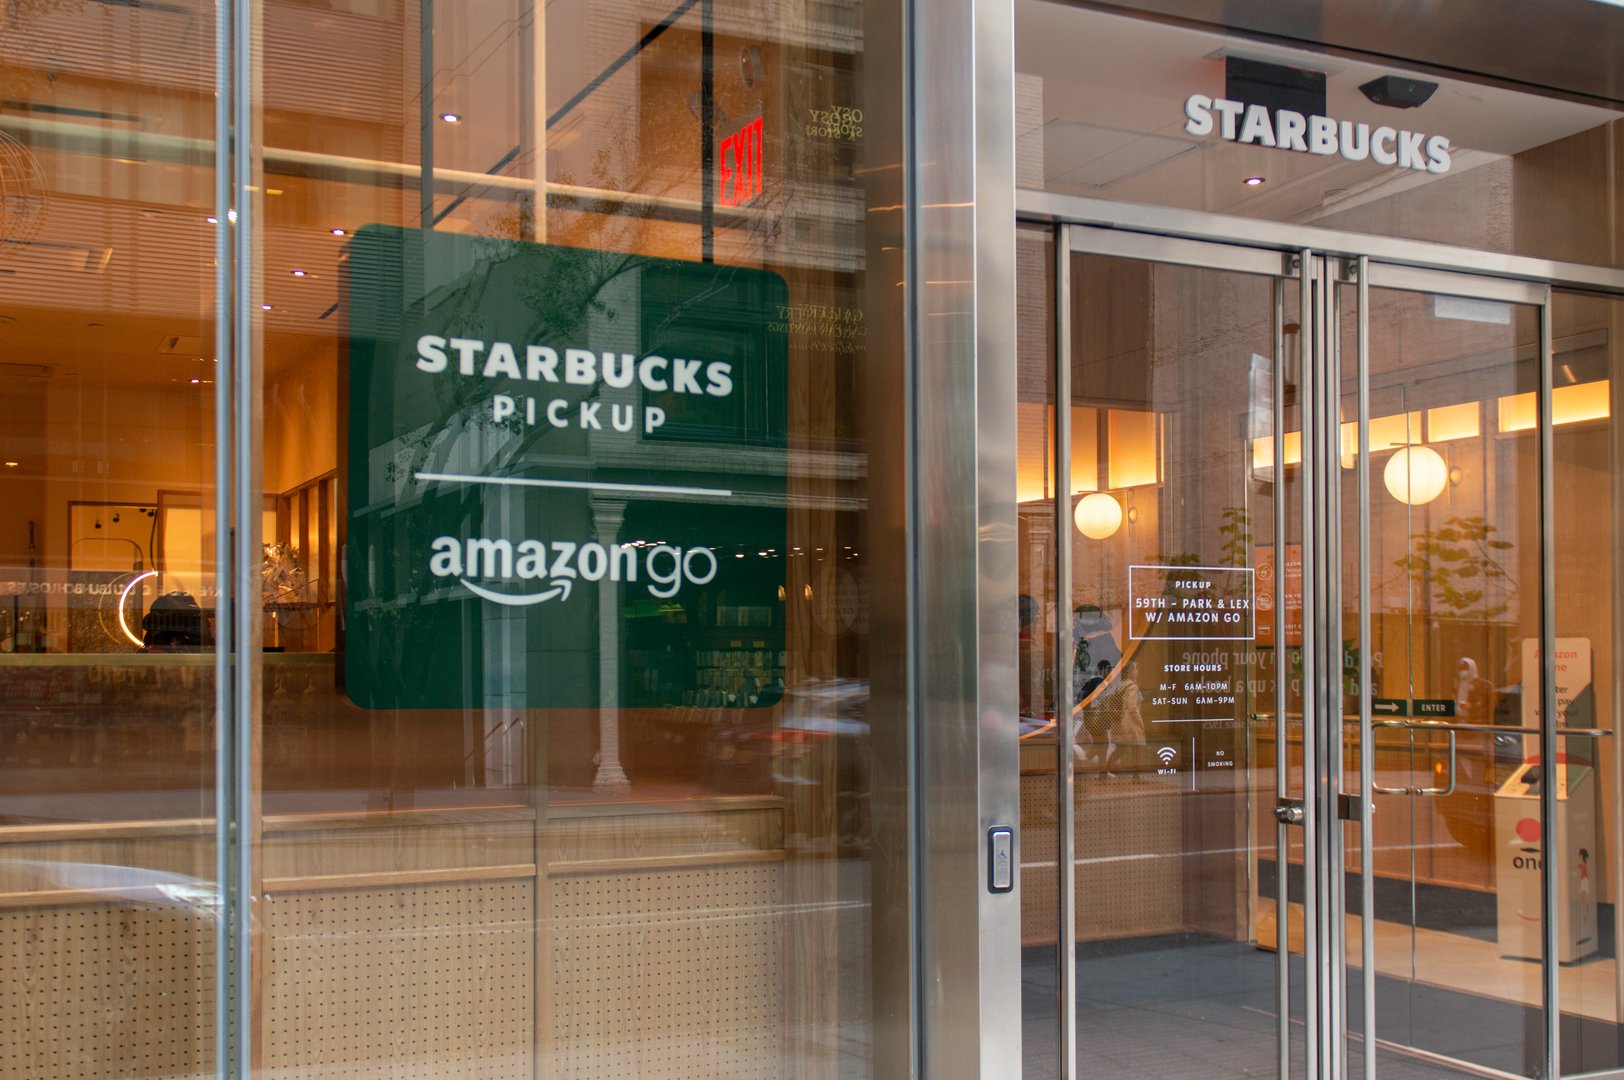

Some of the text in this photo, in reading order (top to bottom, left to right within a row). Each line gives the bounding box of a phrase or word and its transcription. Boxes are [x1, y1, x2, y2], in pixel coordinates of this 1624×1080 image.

[1184, 94, 1451, 174] STARBUCKS
[720, 115, 763, 208] EXIT
[416, 334, 733, 397] STARBUCKS
[493, 395, 666, 433] PICKUP
[430, 536, 718, 599] amazon go
[1175, 580, 1211, 589] PICKUP
[1135, 598, 1166, 609] 59TH
[1182, 598, 1213, 609] PARK
[1217, 599, 1225, 609] &
[1230, 599, 1250, 609] LEX
[1145, 612, 1241, 623] W/ AMAZON GO
[1164, 664, 1222, 672] STORE HOURS
[1160, 683, 1228, 691] M-F 6AM-10PM
[1152, 697, 1235, 705] SAT-SUN 6AM-9PM
[1421, 704, 1447, 712] ENTER
[1513, 856, 1541, 870] on
